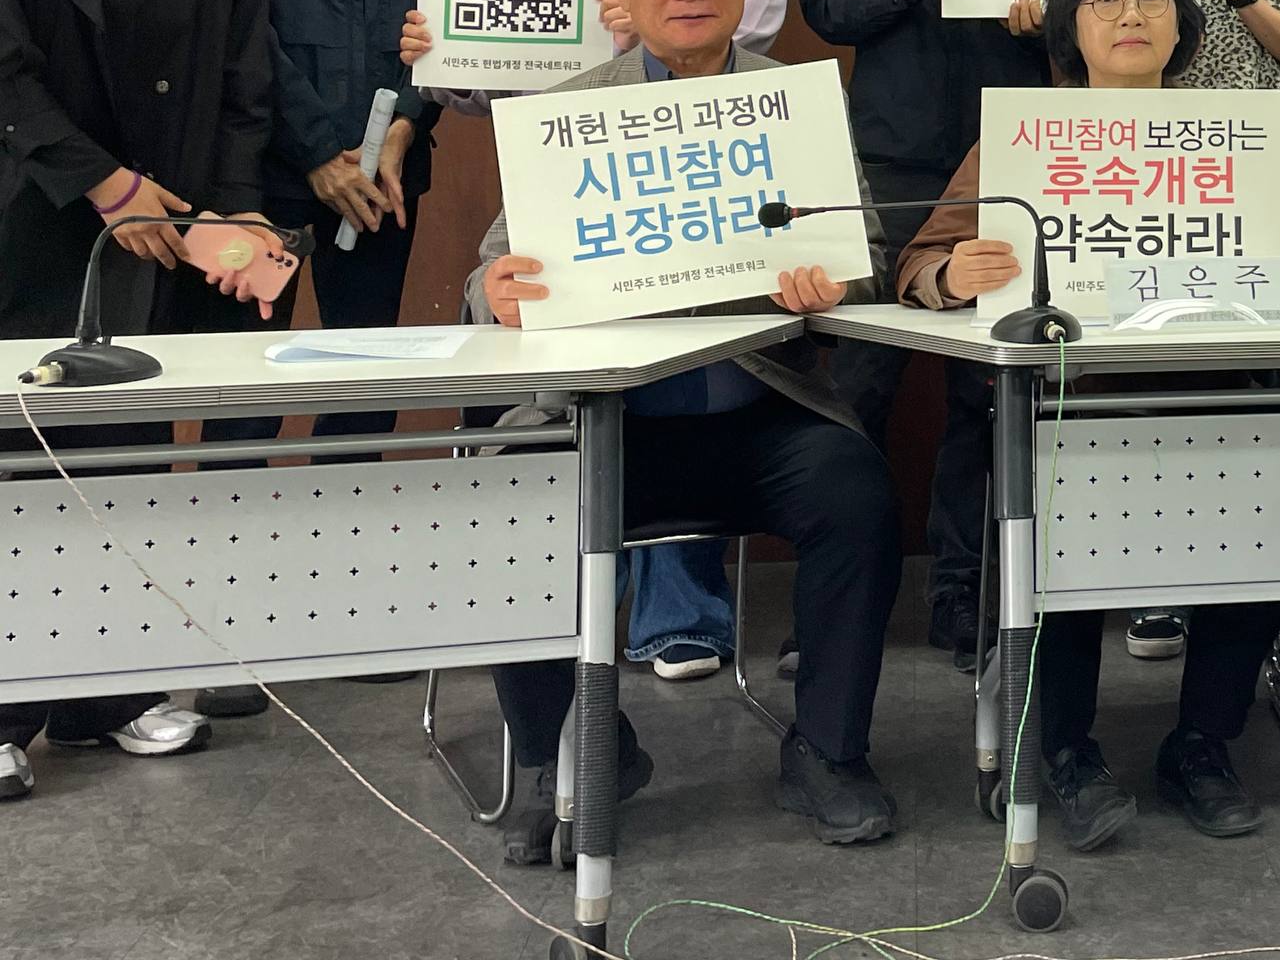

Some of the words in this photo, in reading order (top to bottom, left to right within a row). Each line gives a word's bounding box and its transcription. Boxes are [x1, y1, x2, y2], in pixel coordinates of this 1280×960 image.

[442, 57, 479, 68] 시민주도
[482, 59, 521, 70] 헌법개정
[524, 60, 582, 71] 전국네트워크
[540, 111, 609, 148] 개헌
[617, 102, 684, 140] 논의
[692, 89, 790, 130] 과정에
[1011, 118, 1137, 151] 시민참여
[1143, 119, 1267, 152] 보장하는
[573, 132, 775, 202] 시민참여
[1042, 155, 1236, 206] 후속개헌
[1041, 212, 1243, 263] 약속하라!
[612, 275, 657, 293] 시민주도
[658, 267, 702, 287] 헌법개정
[704, 259, 767, 277] 전국네트워크
[1065, 280, 1106, 292] 시민주도
